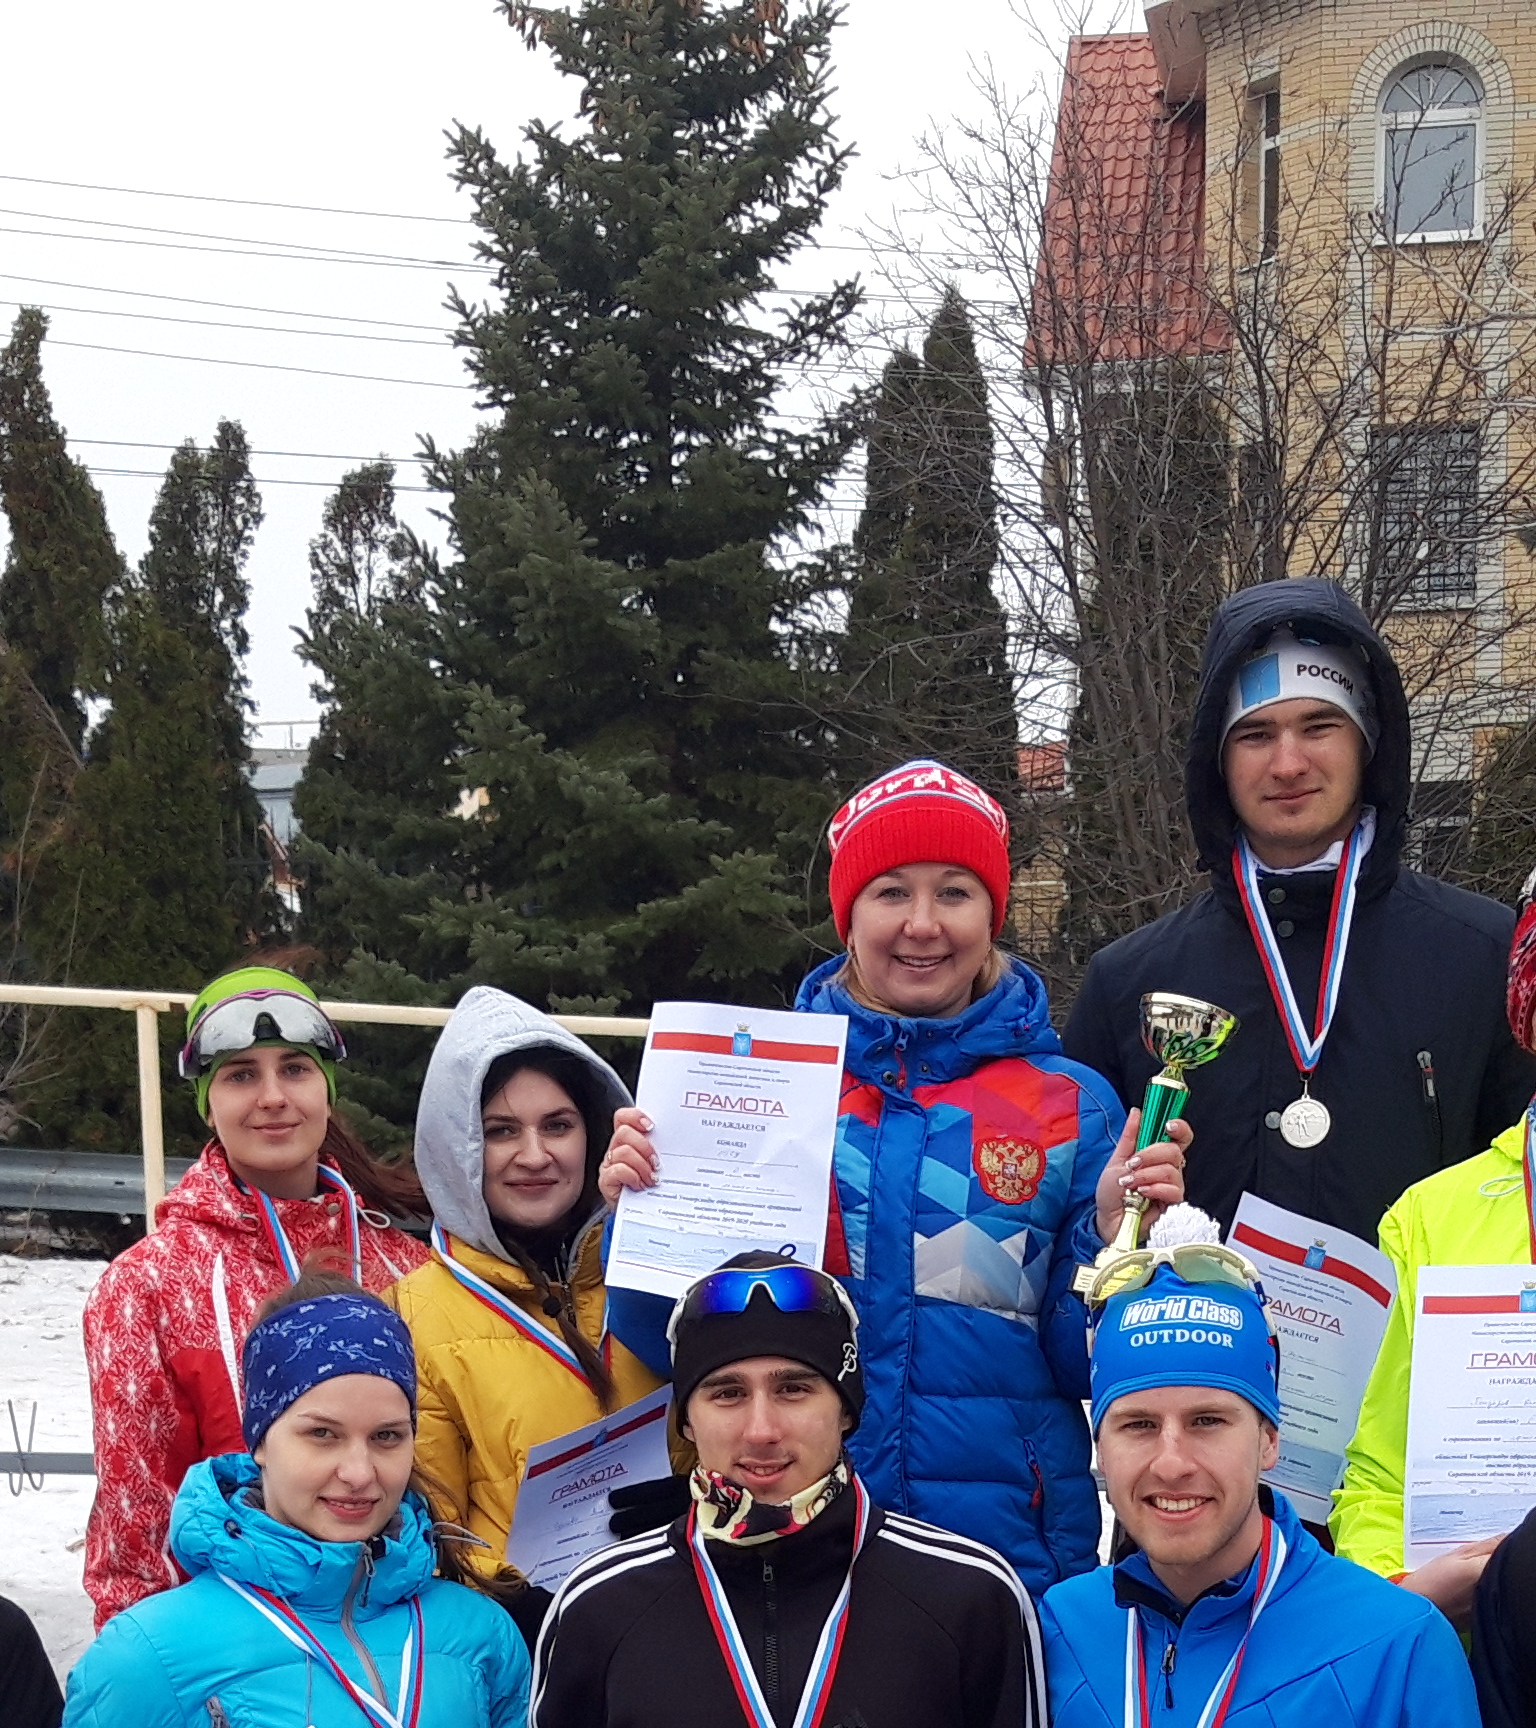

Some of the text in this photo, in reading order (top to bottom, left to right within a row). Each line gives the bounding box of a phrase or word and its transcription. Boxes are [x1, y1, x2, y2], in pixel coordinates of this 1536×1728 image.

[1296, 663, 1354, 696] РОССИИ
[684, 1091, 786, 1115] ГРАМОТА
[701, 1118, 767, 1132] НАГРАЖДАЕТСЯ
[1124, 1299, 1241, 1327] World Class
[1265, 1295, 1342, 1333] РАМОТА
[1130, 1329, 1234, 1349] OUTDOOR
[551, 1462, 624, 1501] ГРАМОТА
